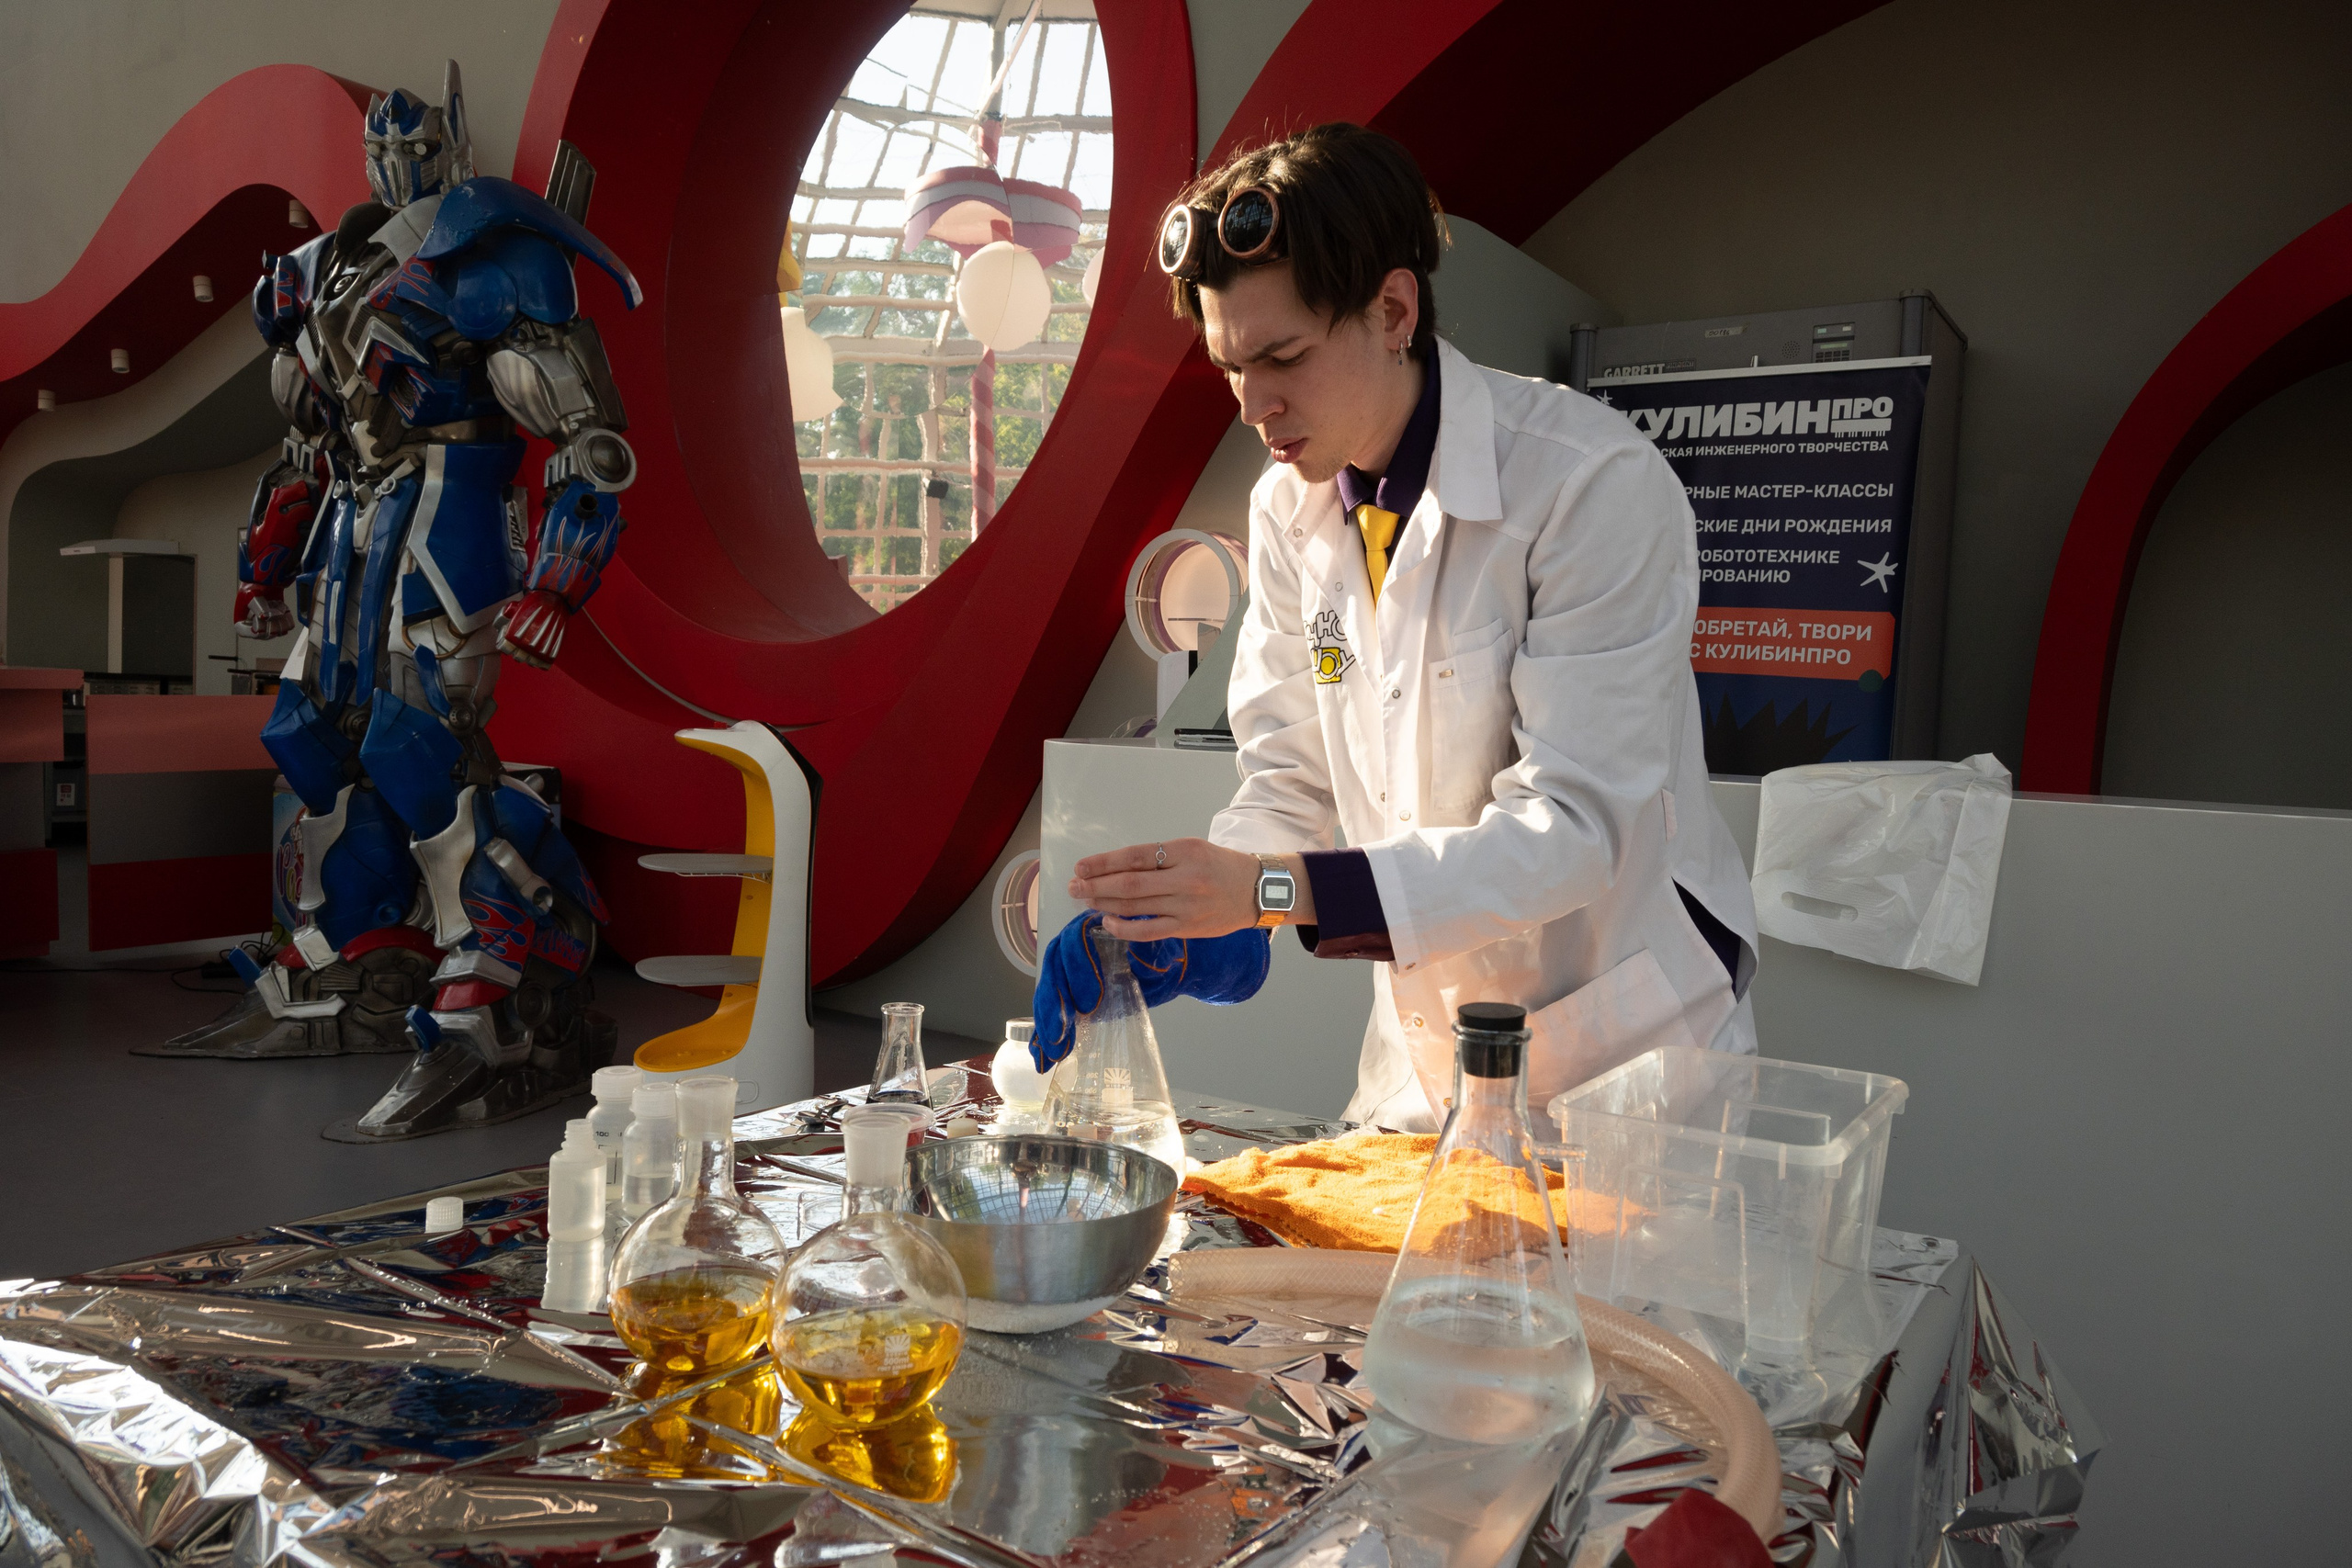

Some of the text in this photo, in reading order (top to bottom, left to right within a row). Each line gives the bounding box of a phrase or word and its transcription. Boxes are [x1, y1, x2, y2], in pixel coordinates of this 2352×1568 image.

[1603, 363, 1666, 378] GARRETT
[1659, 440, 1889, 457] СКАЯ ИНЖЕНЕРНОГО ТВОРЧЕСТВА
[1683, 483, 1894, 499] РНЫЕ МАСТЕР-КЛАССЫ
[1696, 519, 1893, 535] СКИЕ ДНИ РОЖДЕНИЯ
[1700, 569, 1791, 583] РОВАНИЮ
[1693, 618, 1871, 641] ОБРЕТАЙ, ТВОРИ
[1690, 643, 1851, 665] С КУЛИБИНПРО
